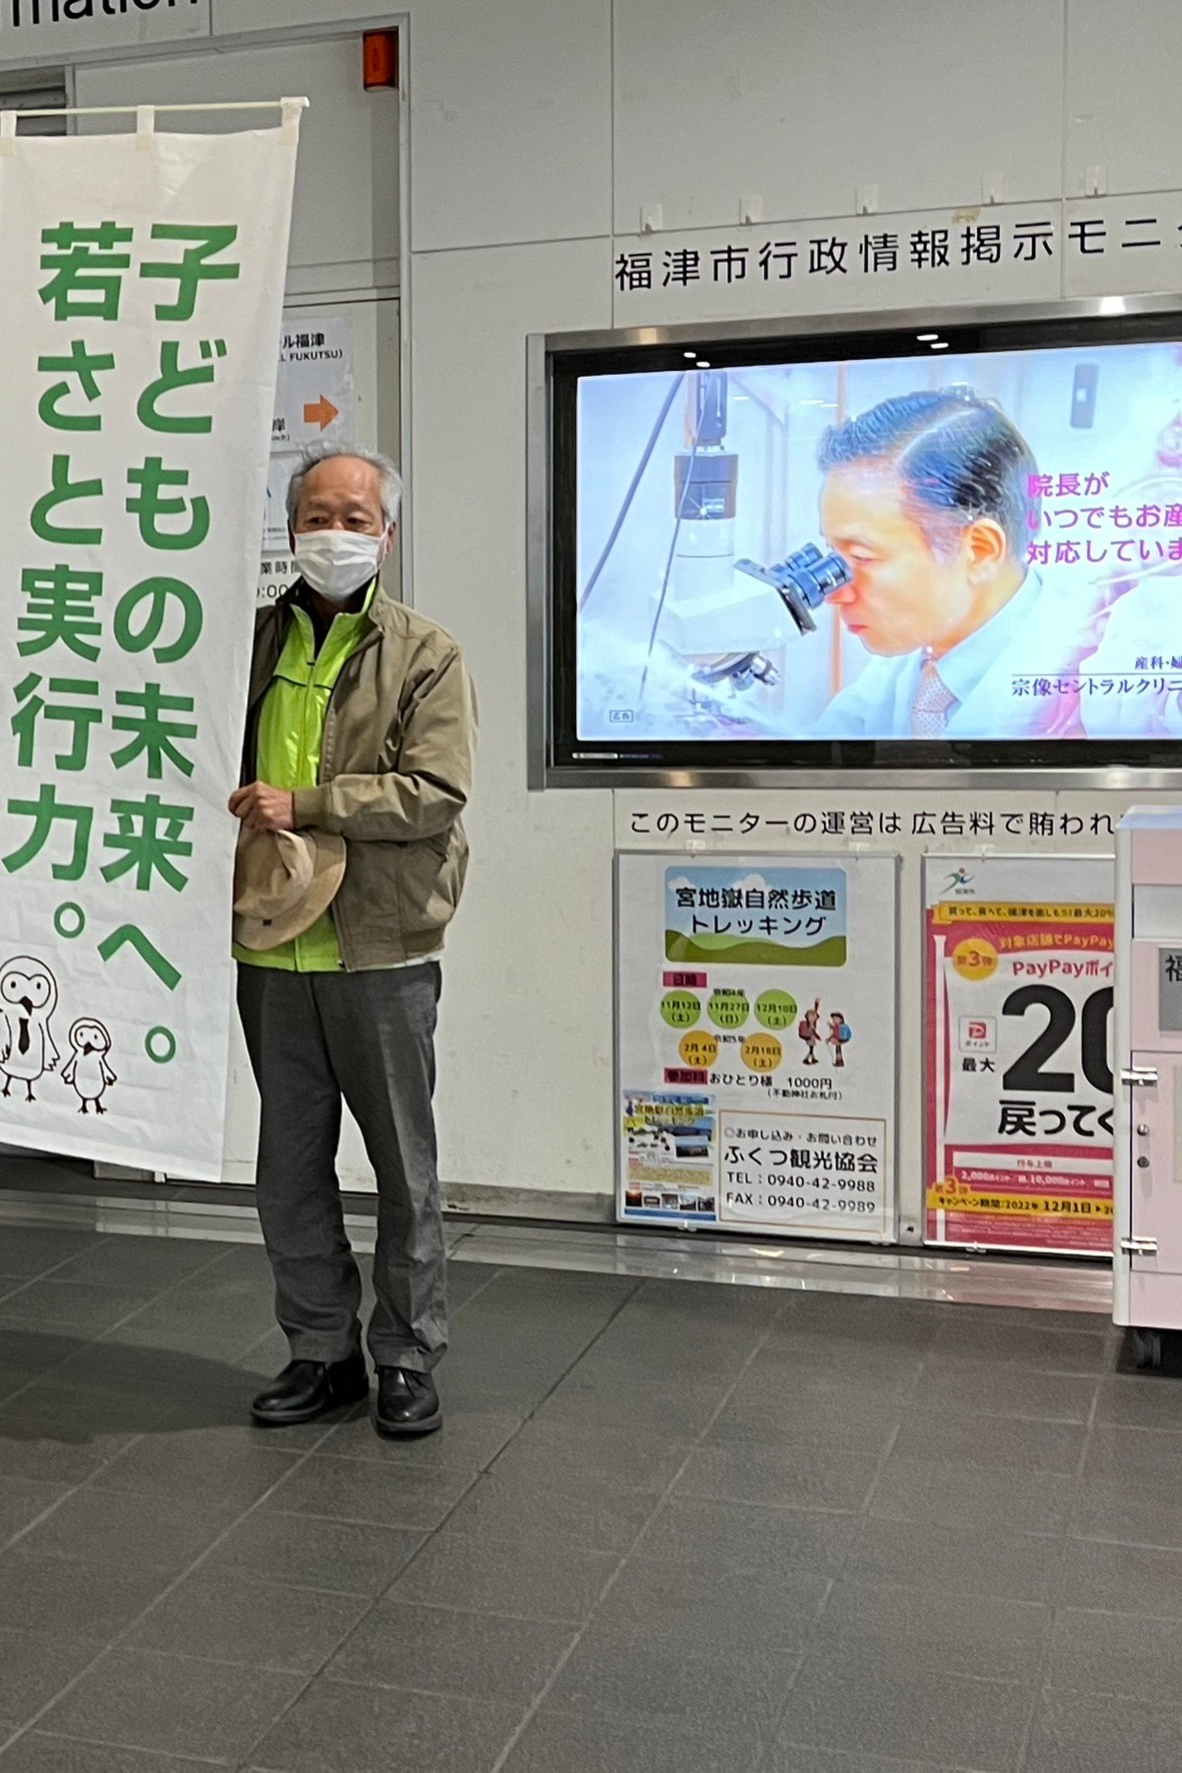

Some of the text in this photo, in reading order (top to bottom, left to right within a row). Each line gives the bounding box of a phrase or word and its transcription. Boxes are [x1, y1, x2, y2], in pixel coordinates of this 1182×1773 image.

[615, 218, 1182, 292] 福津市行政情報掲示モニ
[1027, 471, 1111, 498] 院長が
[1027, 502, 1182, 530] いつでもお産
[2, 221, 134, 938] 若さと実行力。
[97, 224, 240, 1064] 子どもの未来へ。
[675, 887, 837, 911] 宮地嶽自然歩道
[690, 915, 827, 937] トレッキング
[962, 1057, 995, 1073] 最大
[787, 1077, 833, 1090] 1000円
[724, 1146, 878, 1174] ふくつ観光協会
